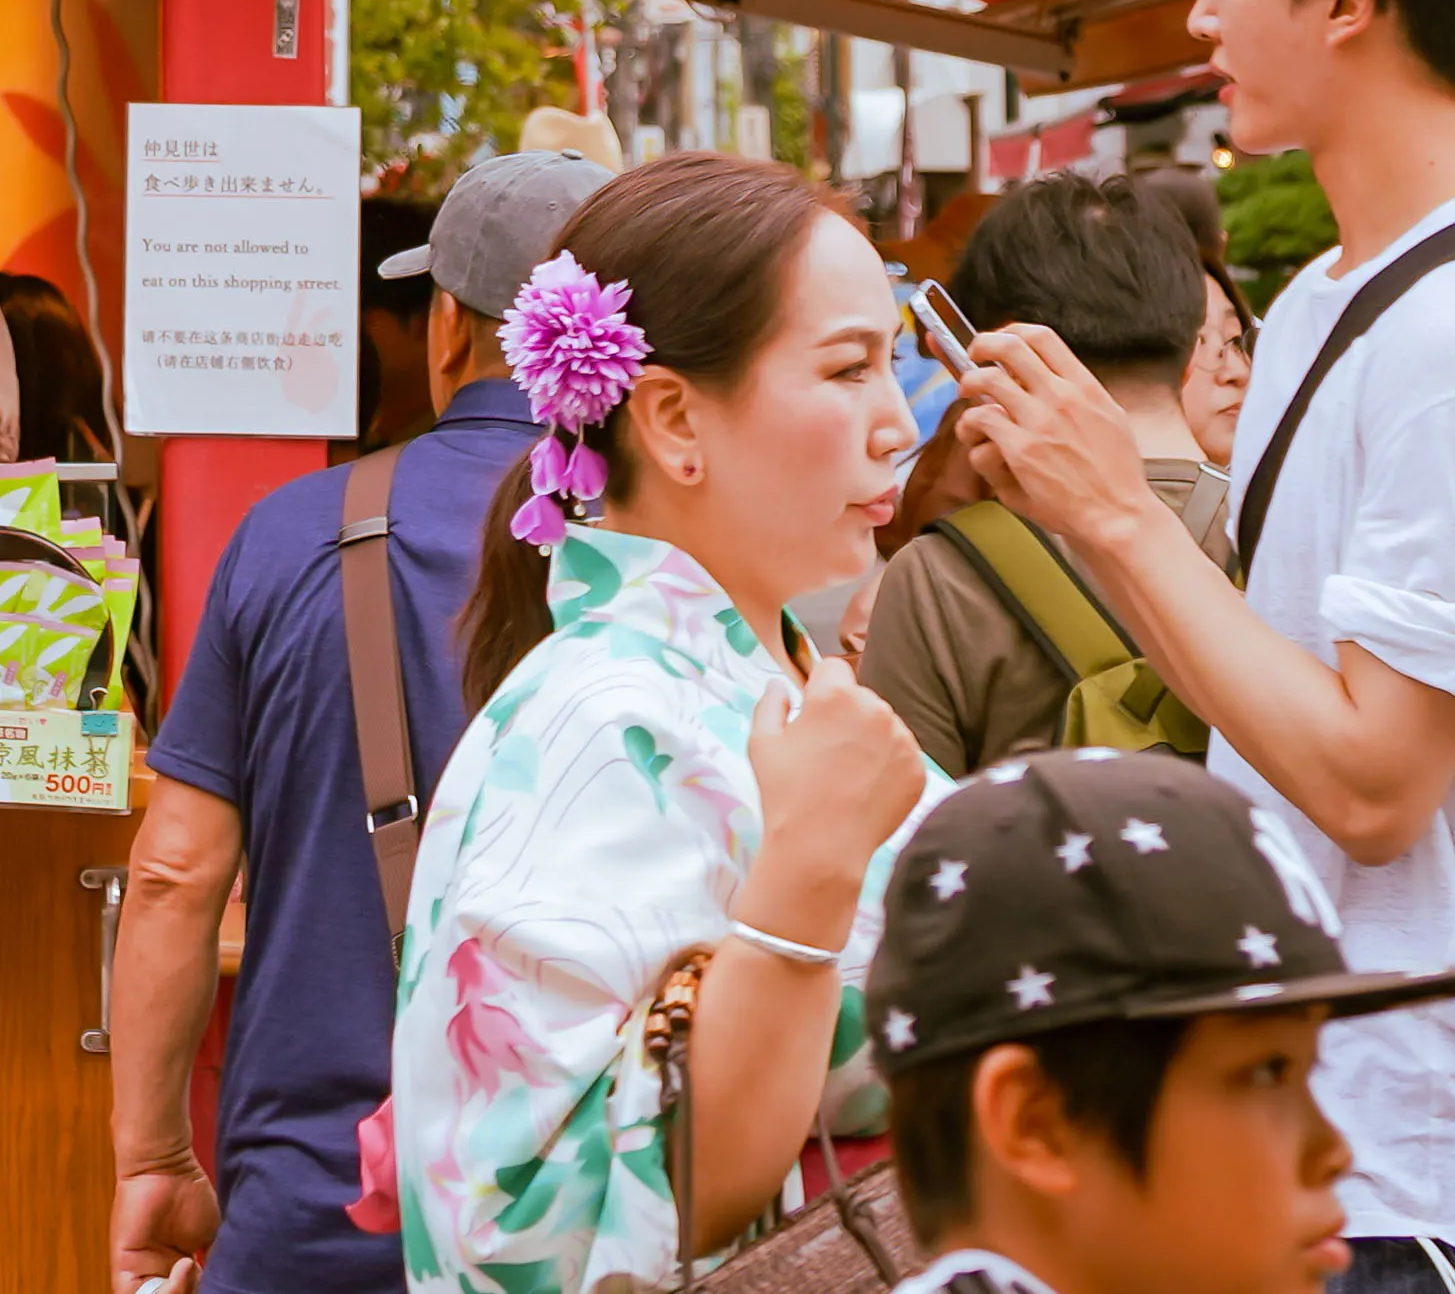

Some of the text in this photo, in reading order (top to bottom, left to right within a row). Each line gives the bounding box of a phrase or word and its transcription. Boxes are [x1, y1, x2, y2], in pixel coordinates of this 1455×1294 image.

[144, 139, 219, 158] 仲見世は
[143, 173, 325, 195] 食べ歩き出来ません。
[142, 239, 309, 255] You are not allowed to
[142, 274, 342, 293] eat on this shopping street.
[45, 773, 105, 796] 500円
